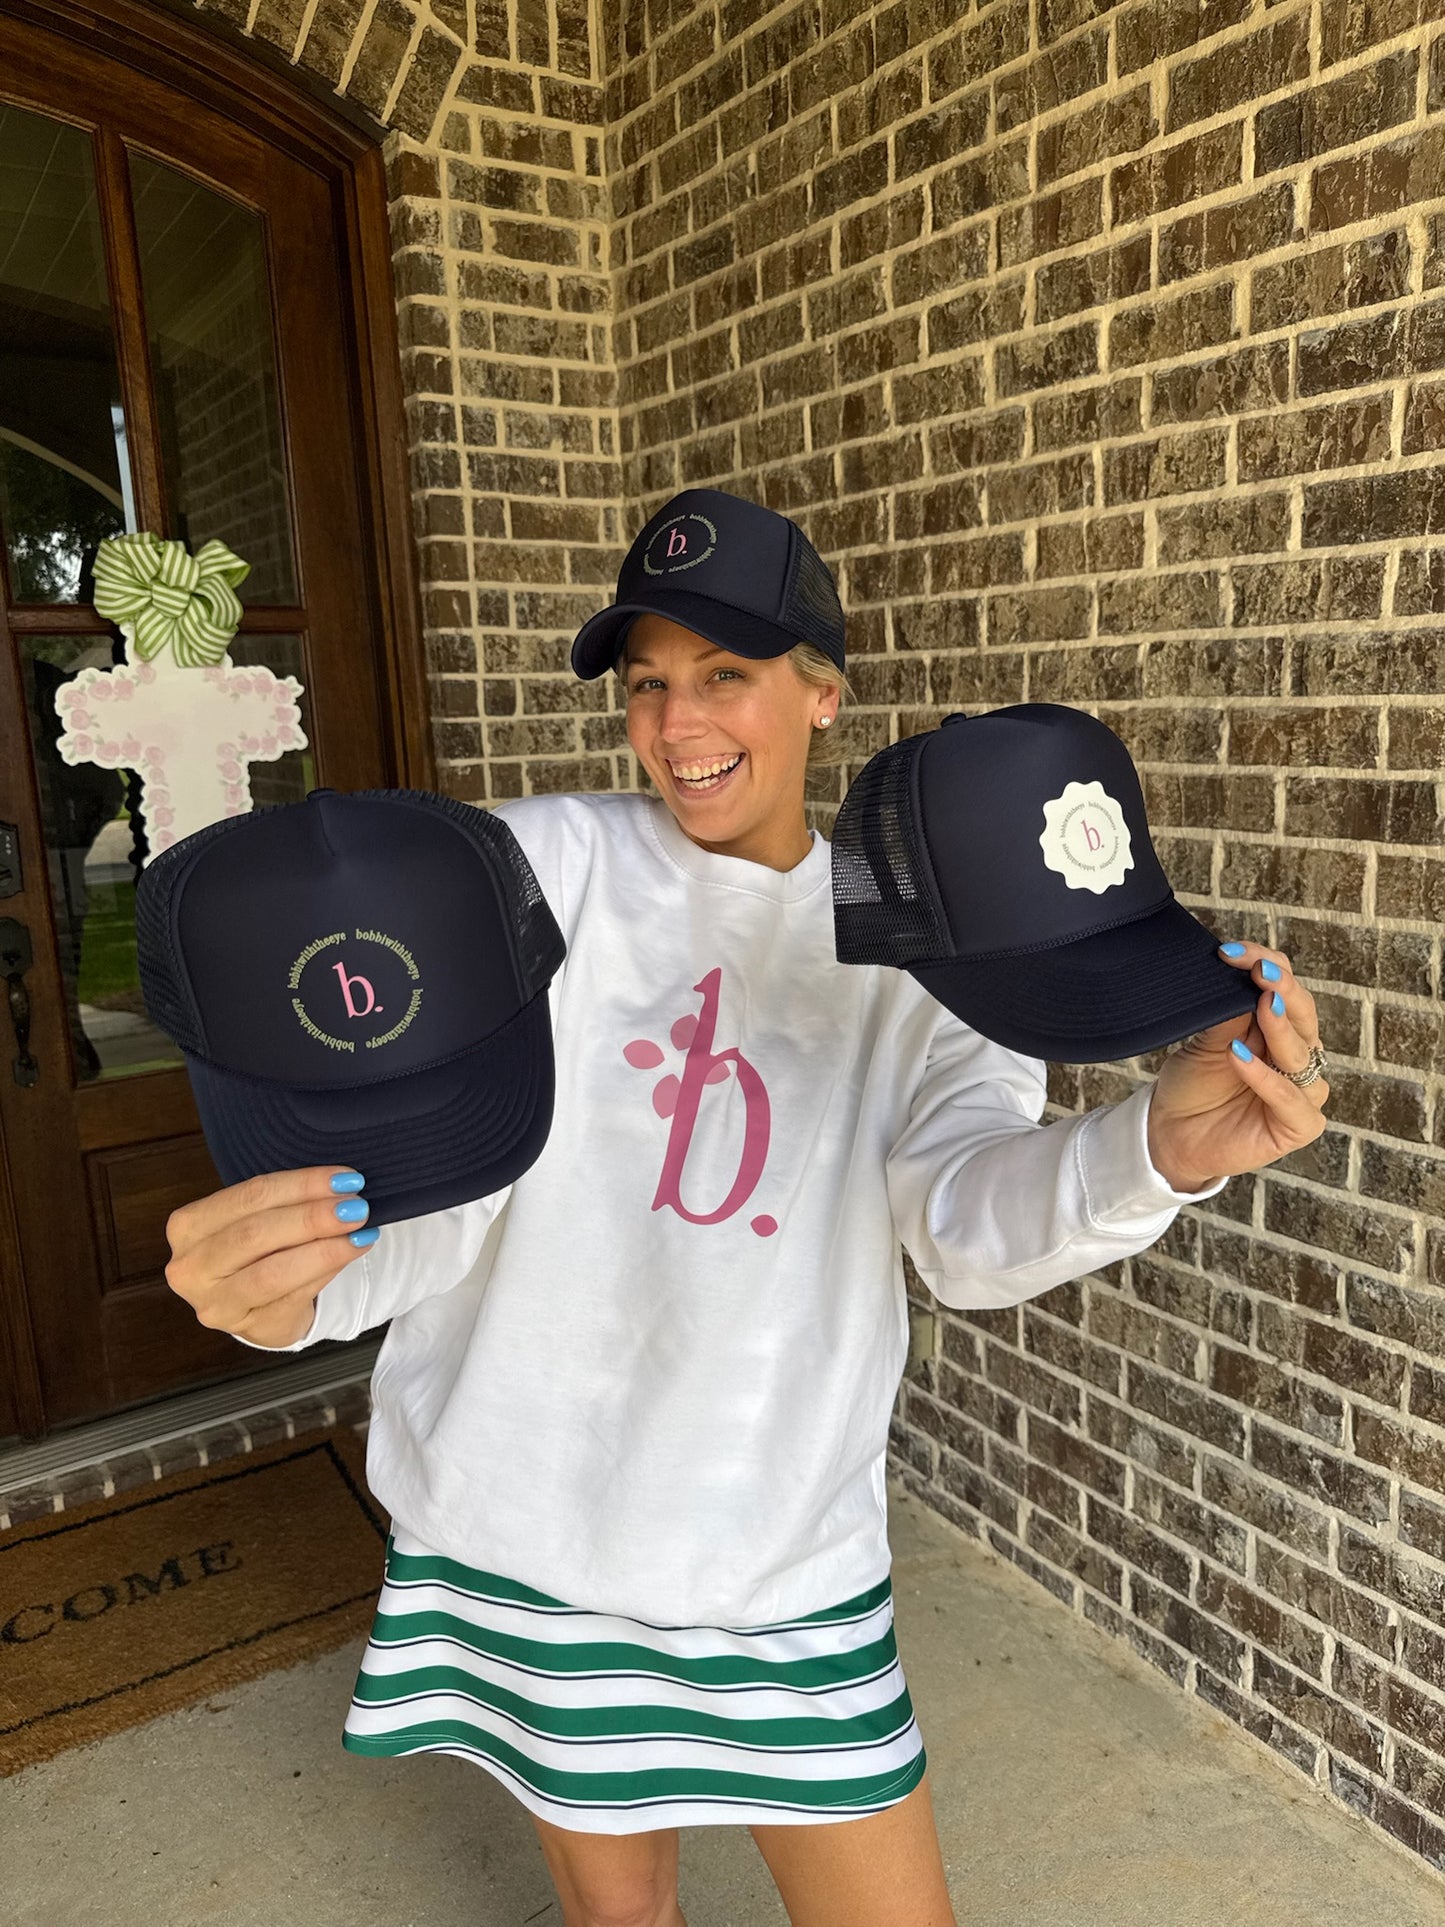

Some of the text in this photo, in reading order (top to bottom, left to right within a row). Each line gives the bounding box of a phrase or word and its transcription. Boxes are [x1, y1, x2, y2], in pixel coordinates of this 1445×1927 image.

[666, 527, 688, 558] b.
[1080, 819, 1105, 852] b.
[287, 932, 347, 990] bobbiwiththeeye
[355, 928, 420, 980] bobbiwiththeeye
[332, 961, 384, 1019] b.
[650, 966, 779, 1238] b.
[1, 1540, 243, 1645] COME
